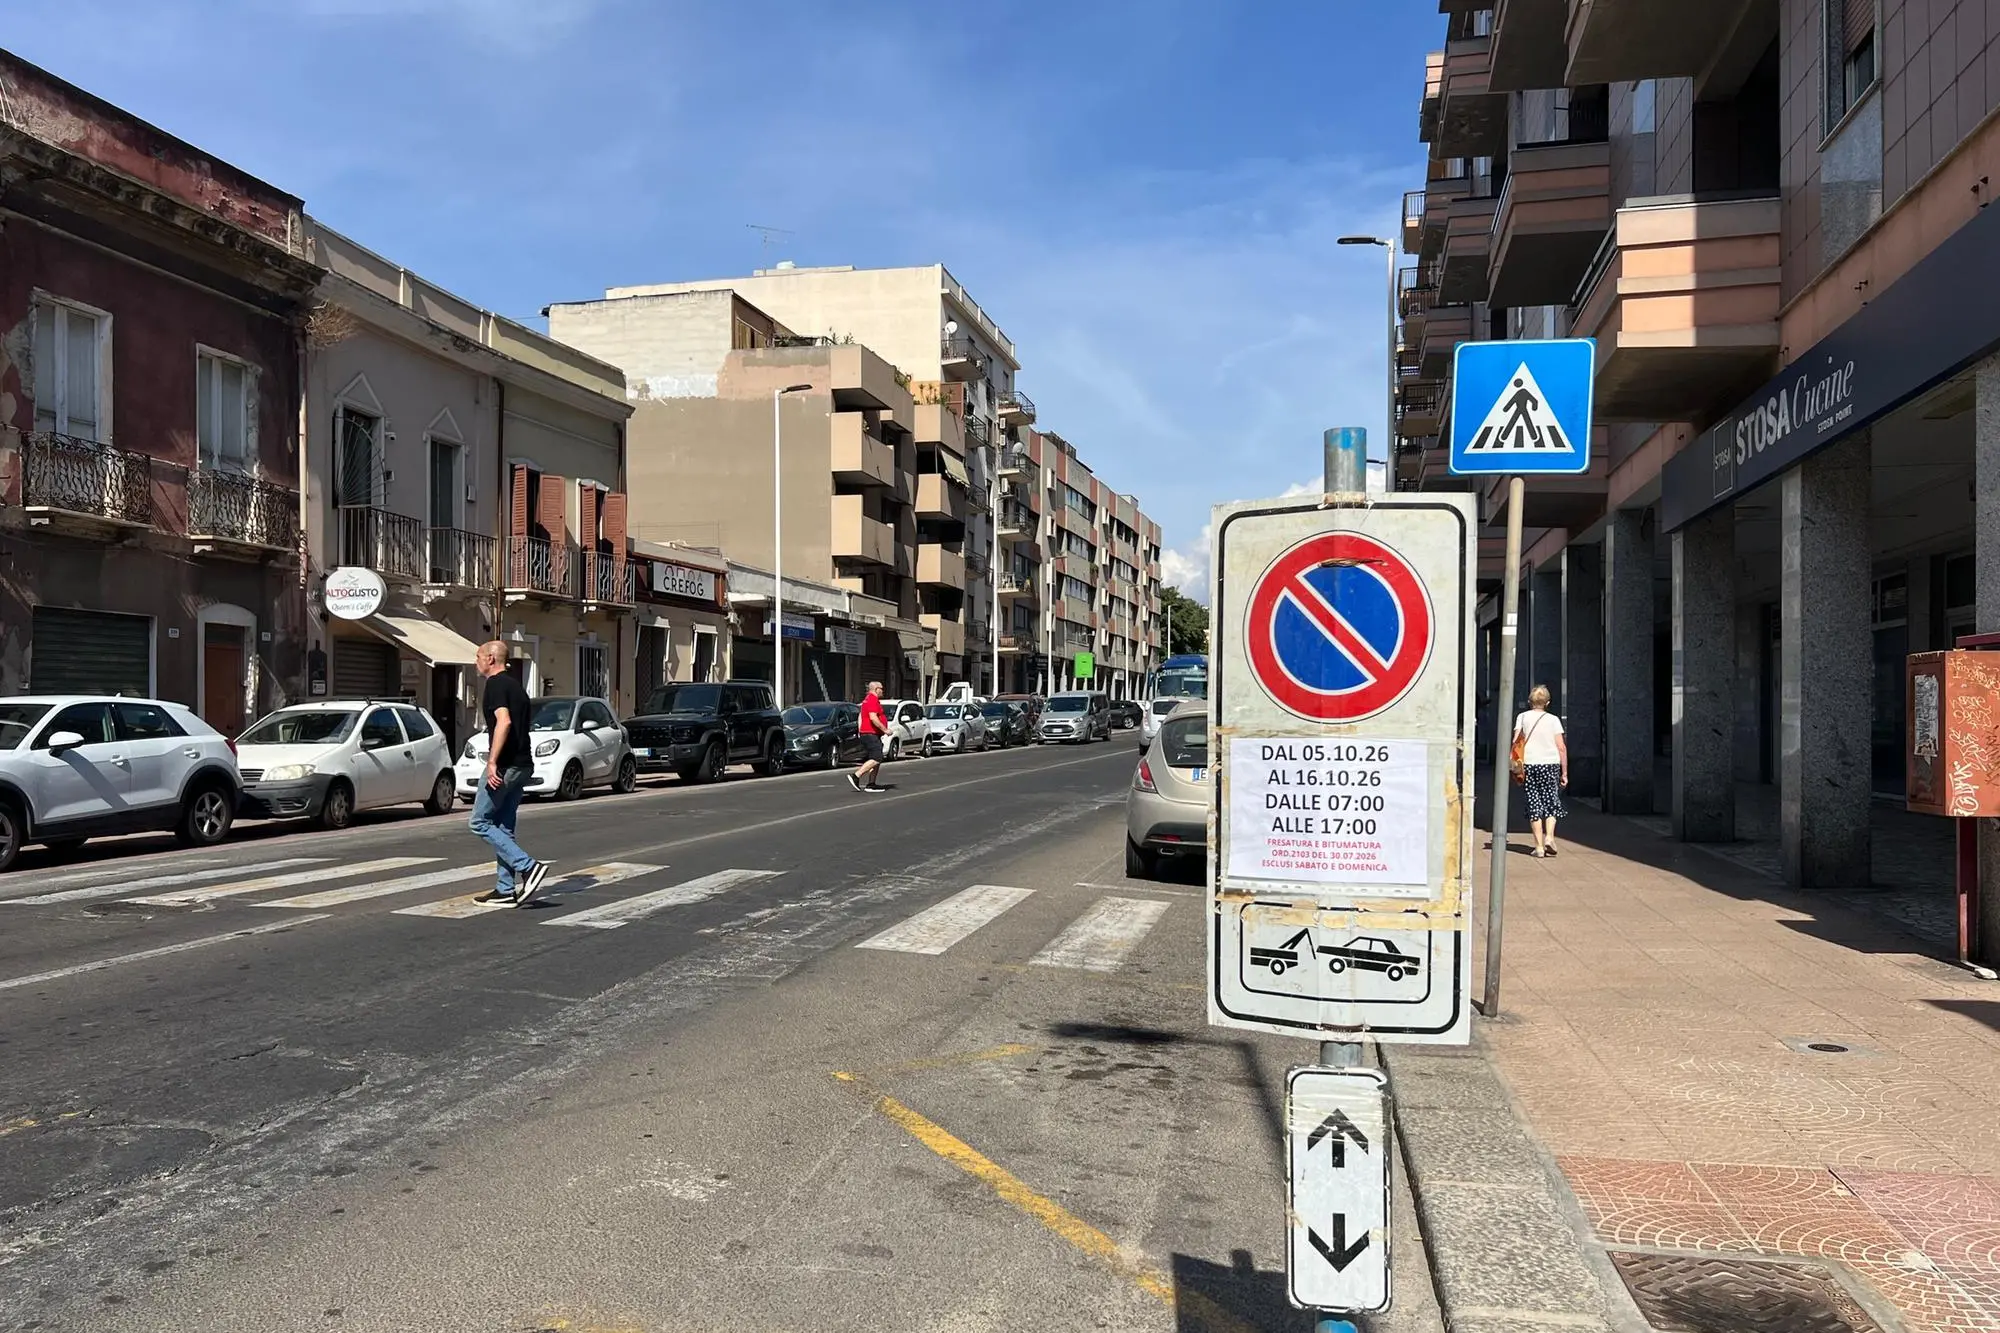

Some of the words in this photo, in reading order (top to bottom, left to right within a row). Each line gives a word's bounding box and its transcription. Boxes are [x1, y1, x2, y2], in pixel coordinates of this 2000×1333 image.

[1735, 388, 1791, 466] STOSA
[1792, 356, 1855, 430] Cucine
[1262, 745, 1297, 761] DAL
[1302, 745, 1389, 762] 05.10.26
[1267, 769, 1290, 785] AL
[1296, 770, 1381, 786] 16.10.26
[1265, 793, 1321, 810] DALLE
[1327, 794, 1385, 811] 07:00
[1271, 816, 1314, 833] ALLE
[1320, 818, 1376, 835] 17:00
[1267, 838, 1313, 848] FRESATURA
[1314, 840, 1319, 848] E
[1321, 840, 1382, 850] BITUMATURA
[1271, 849, 1310, 858] ORD.2103
[1312, 851, 1327, 859] DEL
[1330, 851, 1377, 860] 30.07.2026
[1262, 859, 1293, 868] ESCLUSI
[1295, 861, 1328, 870] SABATO
[1338, 863, 1388, 871] DOMENICA
